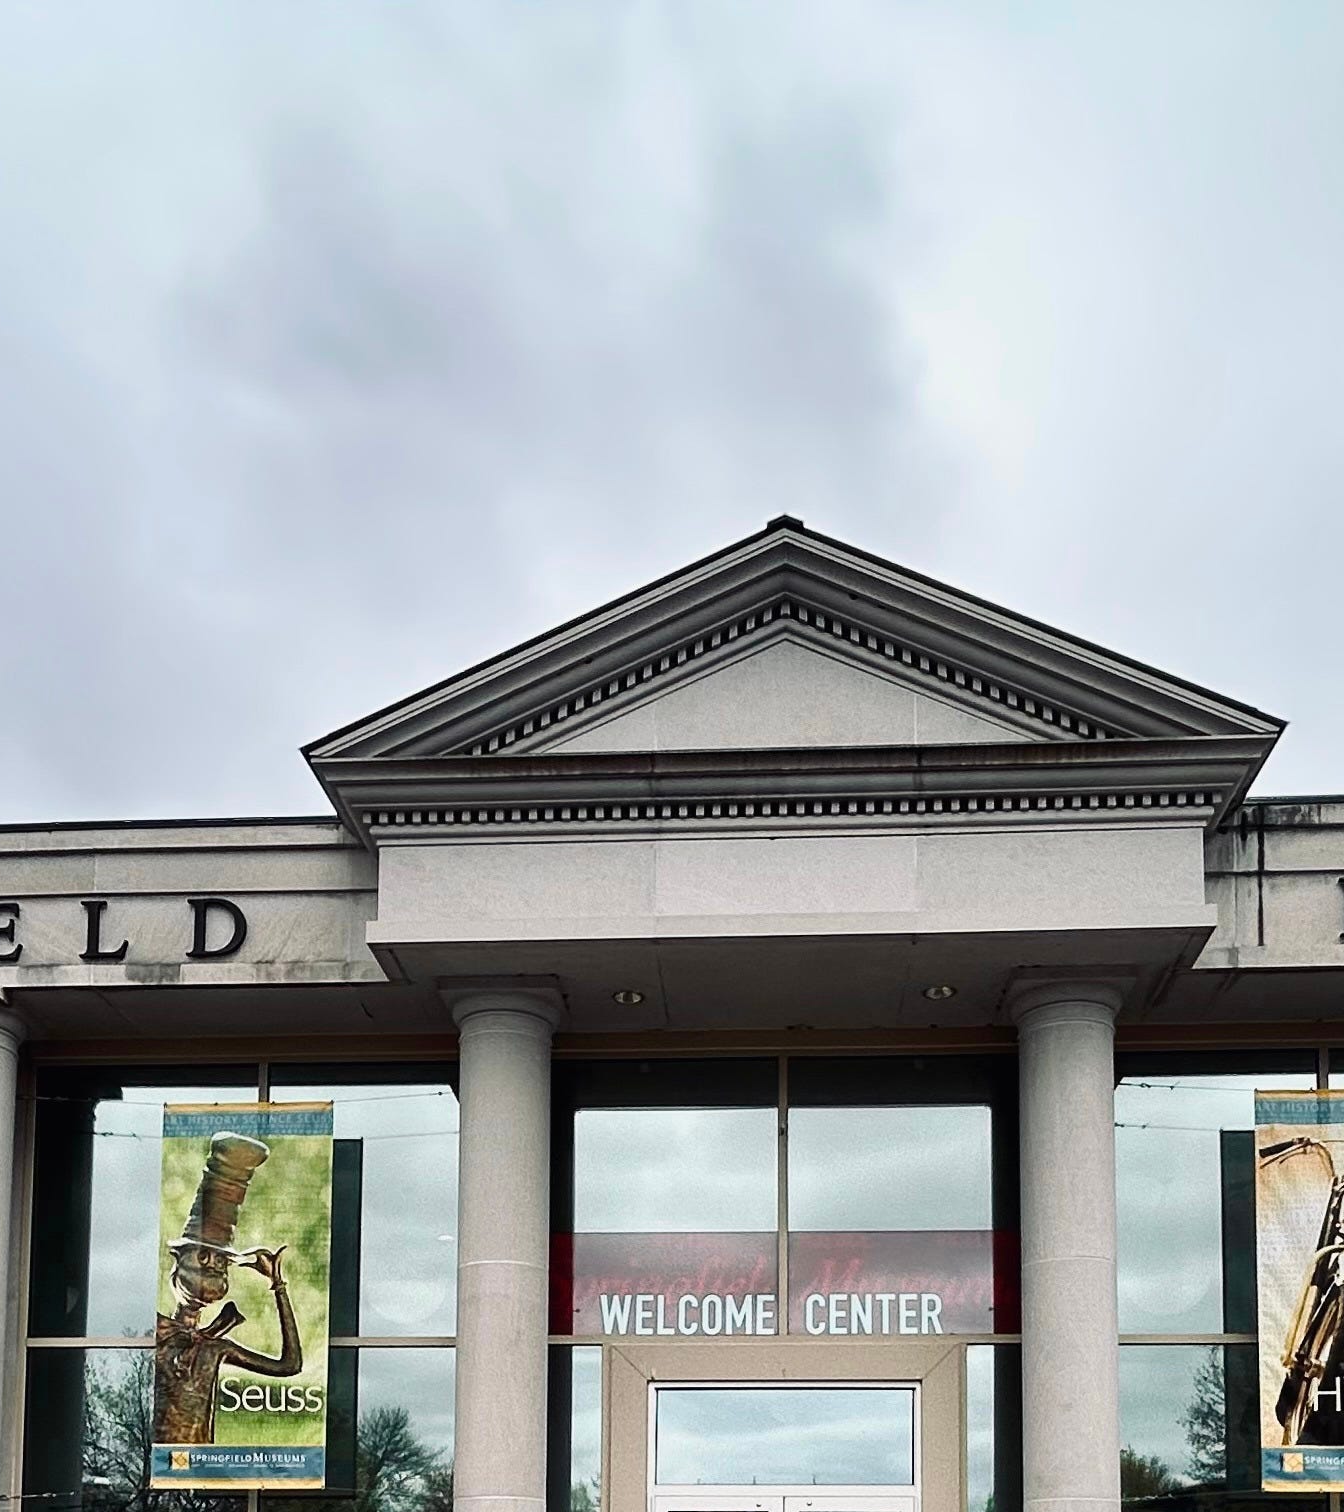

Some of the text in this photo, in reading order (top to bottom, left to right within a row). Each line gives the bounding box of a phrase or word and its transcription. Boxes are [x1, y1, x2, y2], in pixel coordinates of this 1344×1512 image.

[601, 1294, 943, 1335] WELCOME CENTER
[220, 1378, 323, 1413] Seuss
